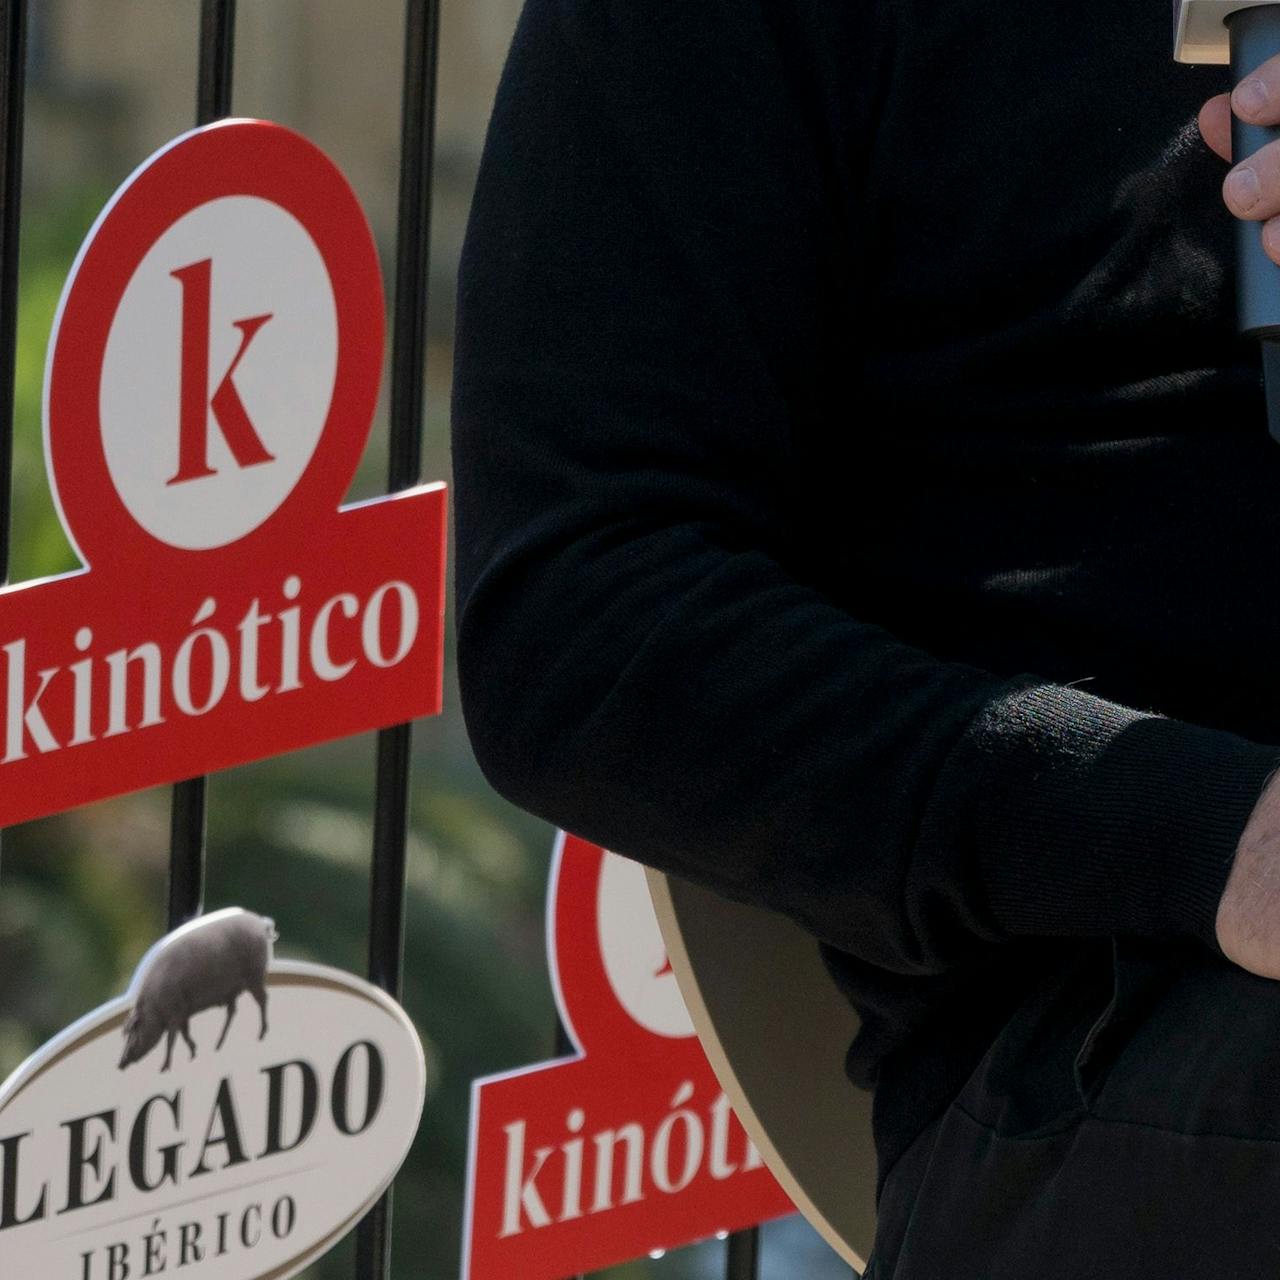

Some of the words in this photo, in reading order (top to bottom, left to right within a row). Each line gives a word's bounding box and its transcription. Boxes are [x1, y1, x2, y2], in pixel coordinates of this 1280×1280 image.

[165, 258, 276, 486] k
[0, 575, 420, 765] kinótico
[79, 1195, 297, 1280] IBÉRICO
